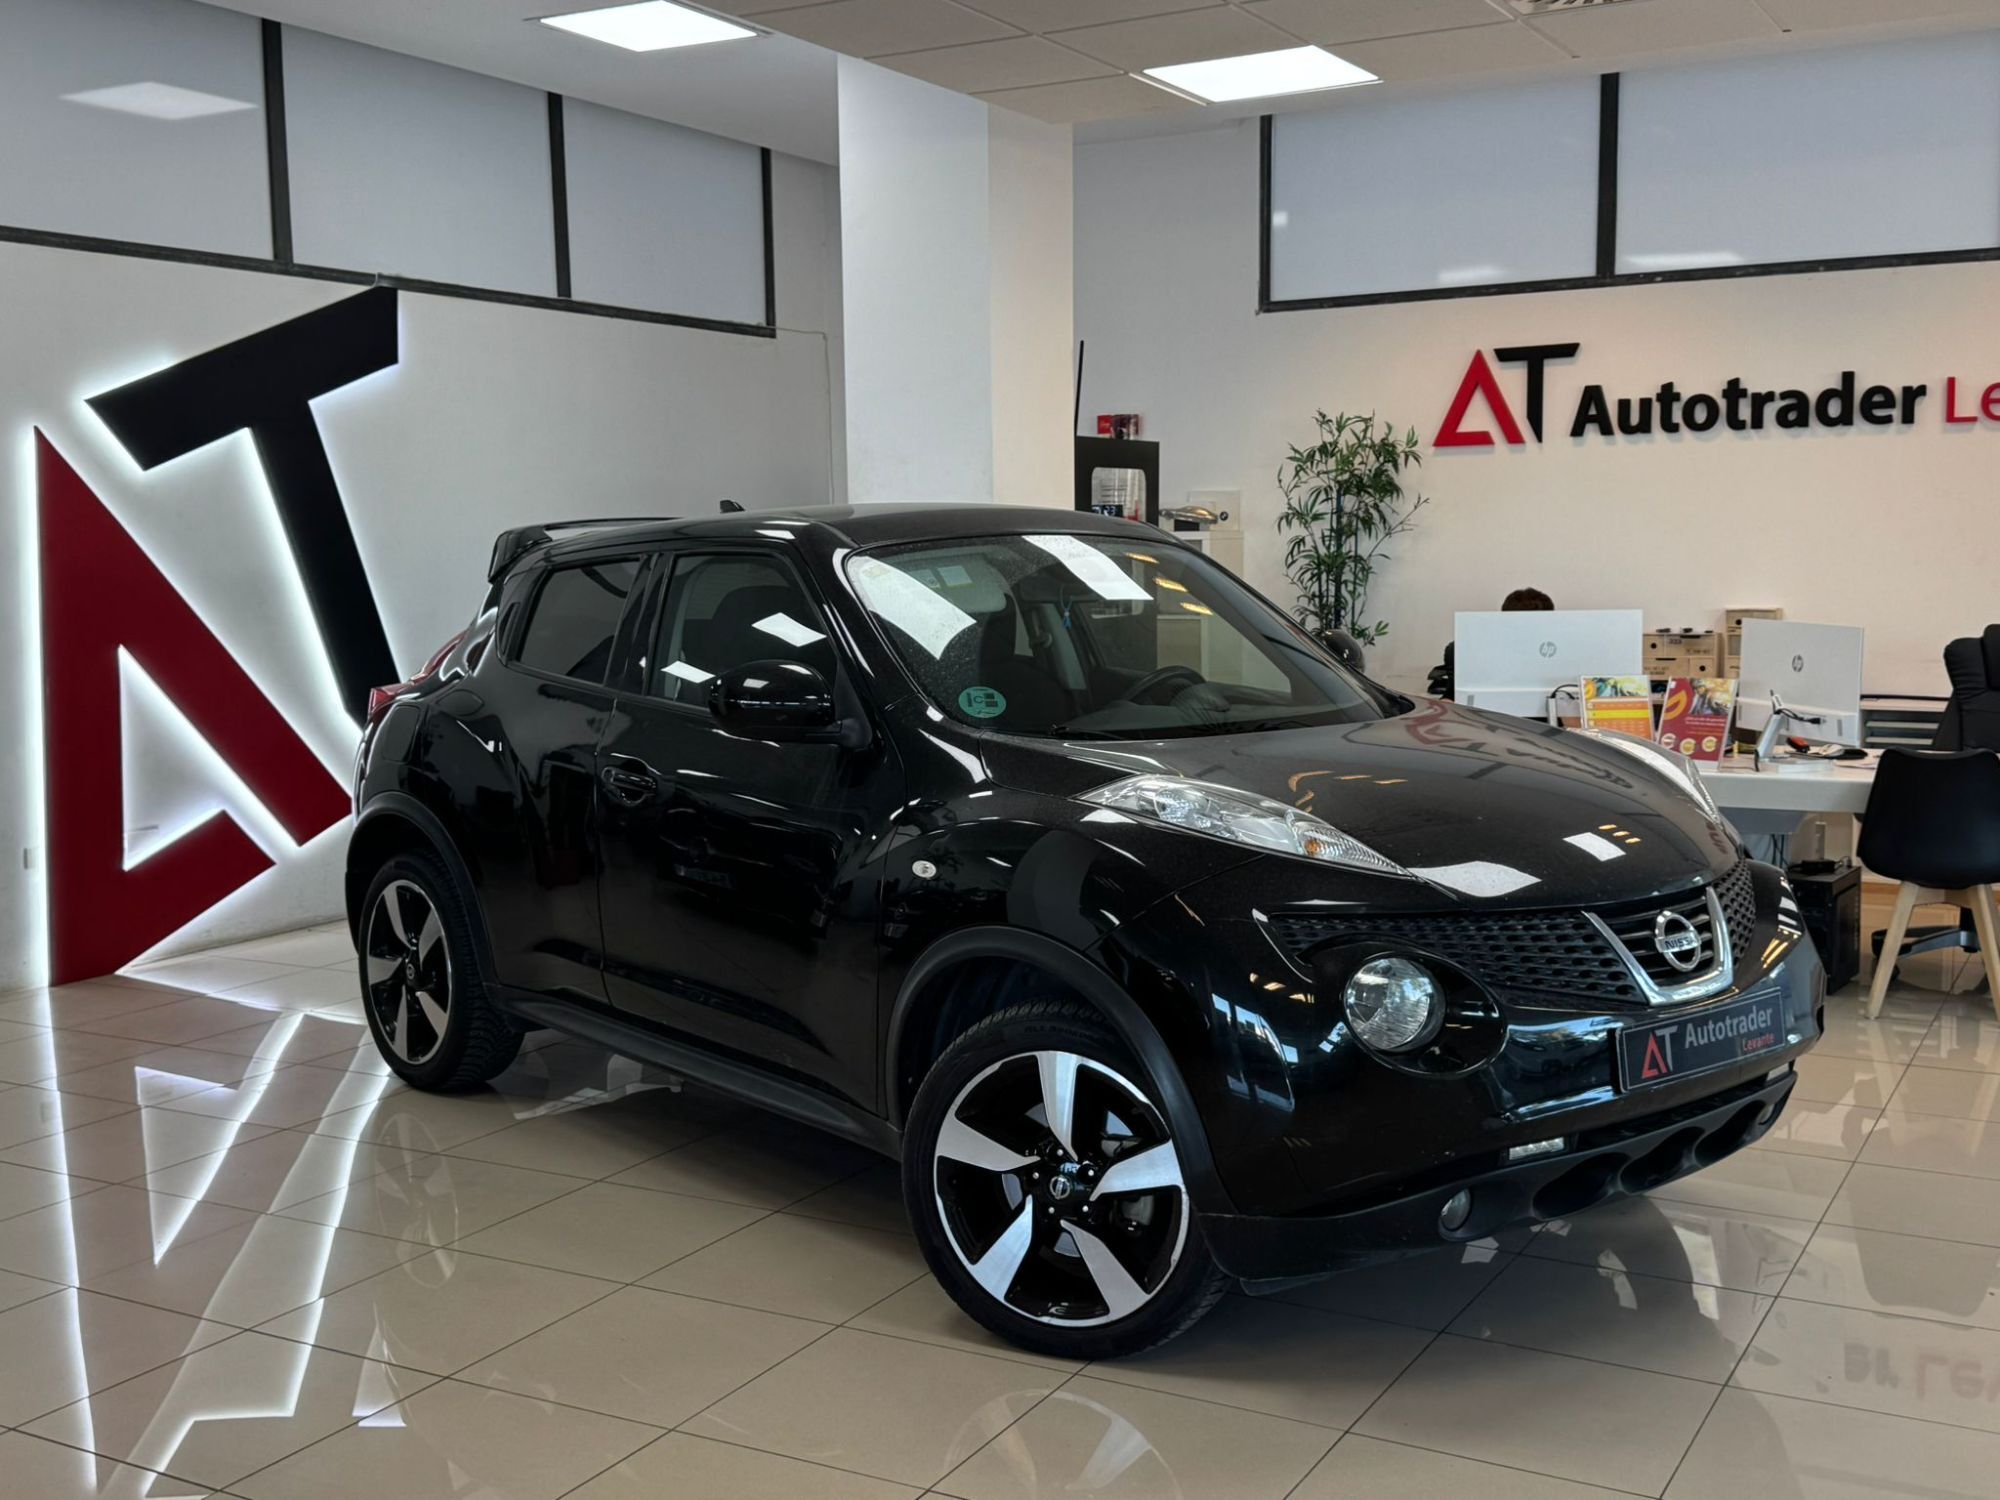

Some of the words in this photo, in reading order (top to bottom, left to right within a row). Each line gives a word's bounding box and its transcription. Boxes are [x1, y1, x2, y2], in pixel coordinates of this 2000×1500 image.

[1432, 342, 1580, 447] AT
[1570, 371, 1928, 438] Autotrader
[1538, 640, 1558, 659] hp
[1641, 1025, 1678, 1079] AT
[1684, 1005, 1773, 1049] Autotrader
[1742, 1032, 1775, 1052] Levante
